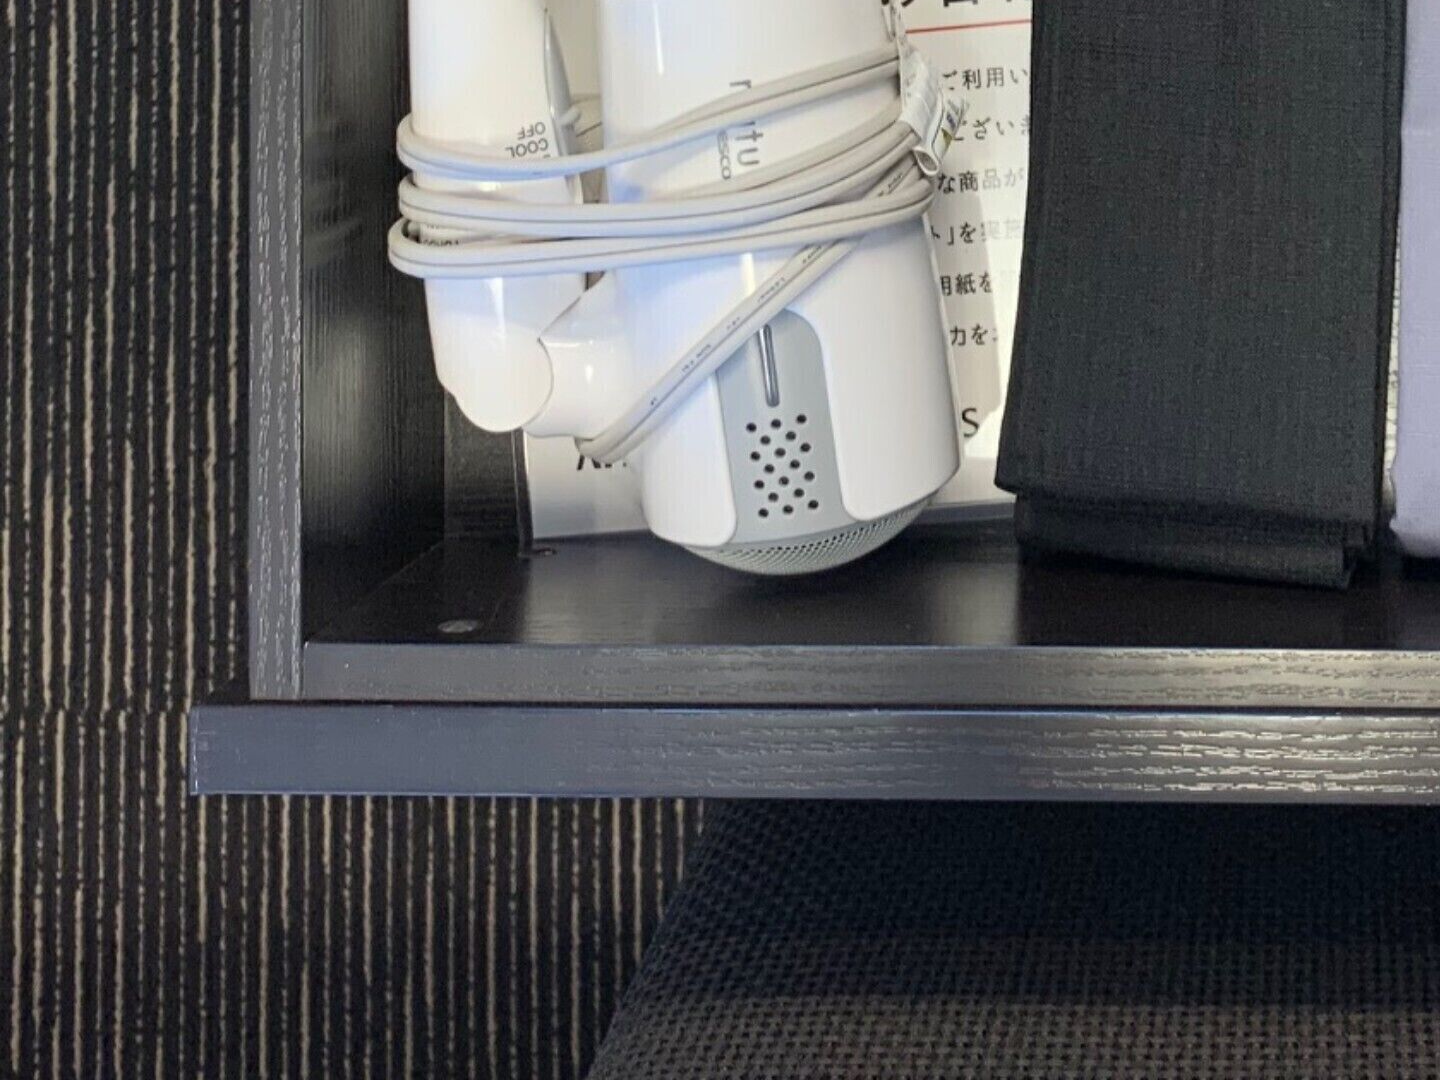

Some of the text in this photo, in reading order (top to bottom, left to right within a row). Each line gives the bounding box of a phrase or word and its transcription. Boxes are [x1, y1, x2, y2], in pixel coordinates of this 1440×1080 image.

[517, 121, 546, 141] OFF
[505, 137, 549, 158] COOL
[937, 169, 1025, 195] な商品が
